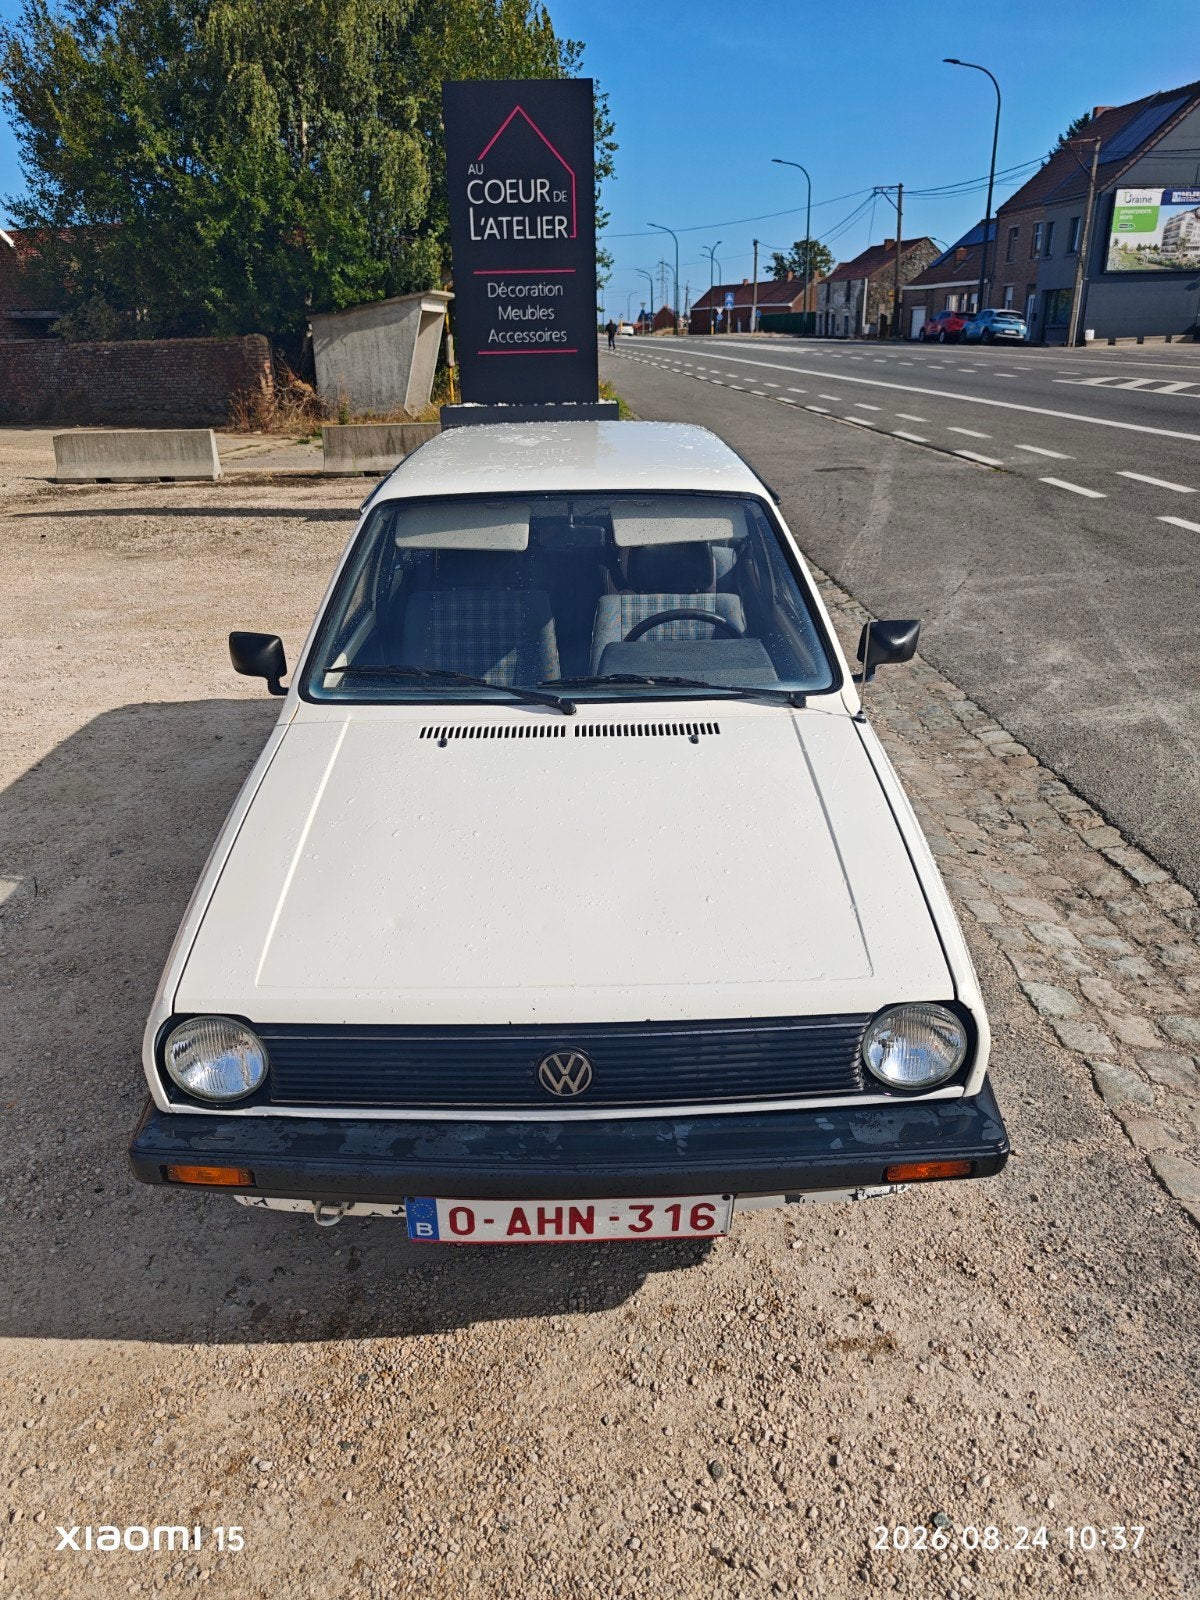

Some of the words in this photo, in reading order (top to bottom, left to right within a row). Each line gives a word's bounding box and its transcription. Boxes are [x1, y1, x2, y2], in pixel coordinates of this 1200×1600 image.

[467, 163, 484, 176] AU
[466, 178, 551, 205] COEUR
[553, 190, 568, 203] DE
[468, 206, 569, 241] L'ATELIER
[487, 282, 564, 299] Décoration
[498, 305, 556, 321] Meubles
[487, 328, 568, 344] Accessoires
[415, 1222, 434, 1236] B
